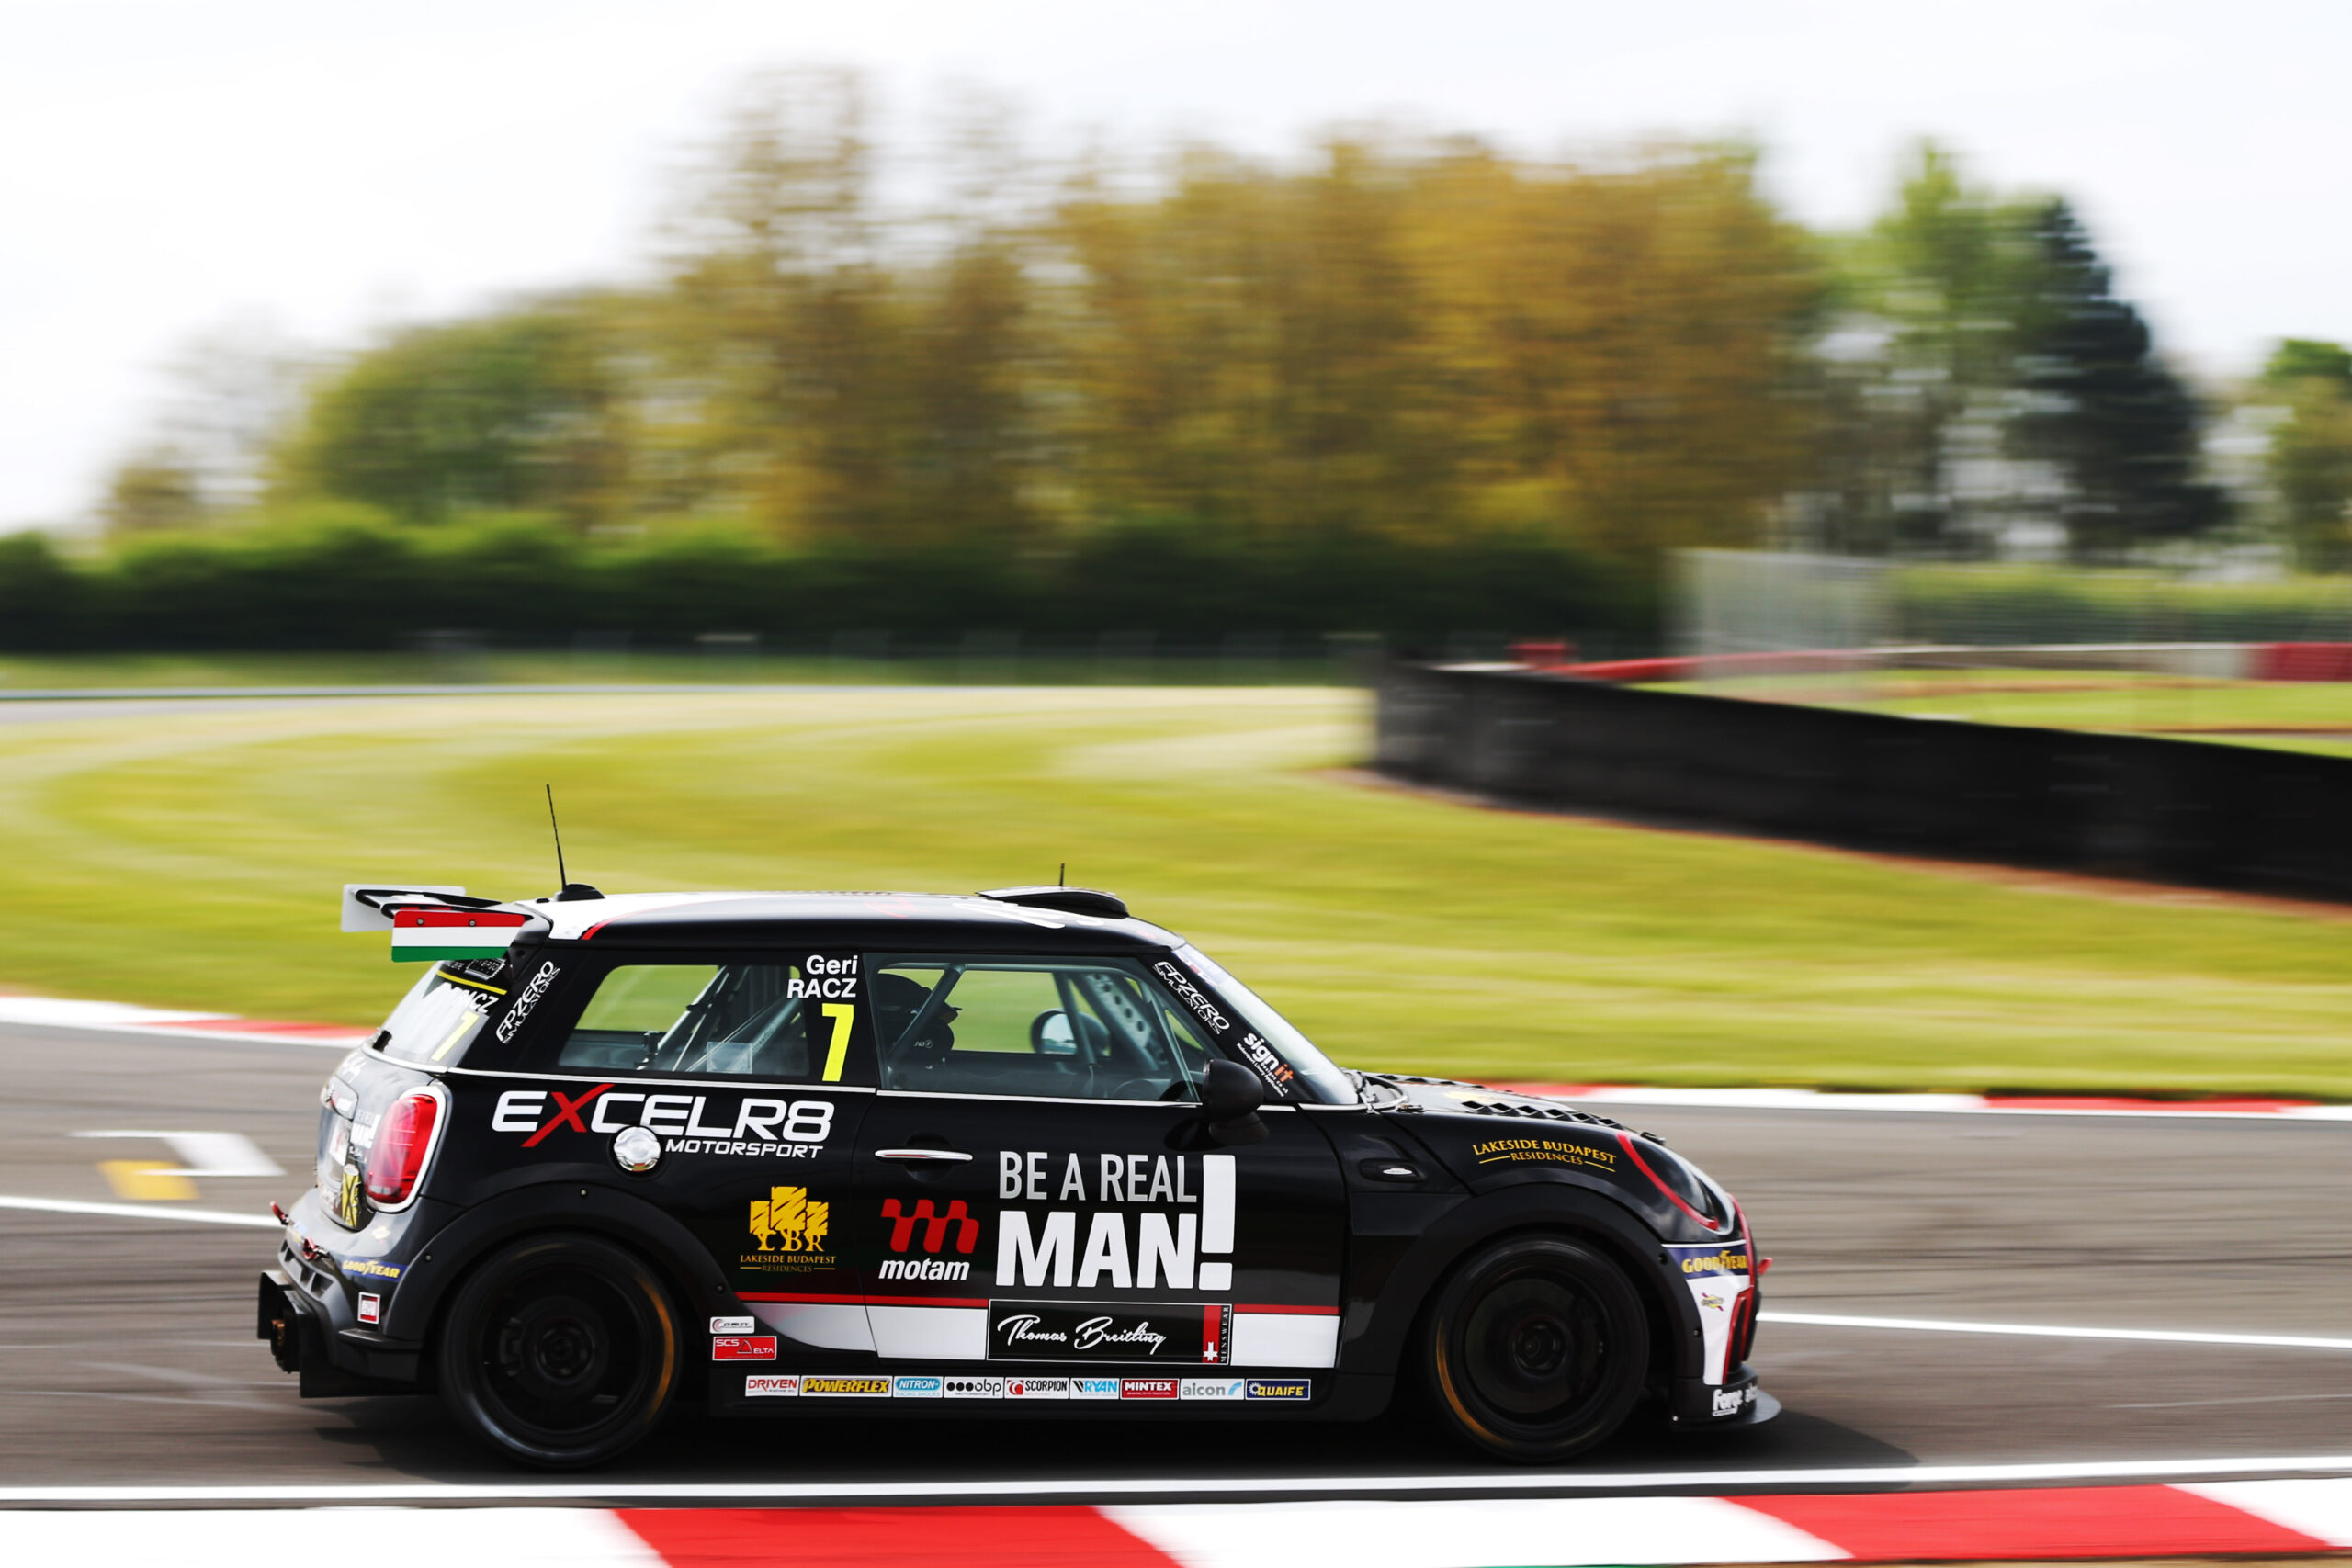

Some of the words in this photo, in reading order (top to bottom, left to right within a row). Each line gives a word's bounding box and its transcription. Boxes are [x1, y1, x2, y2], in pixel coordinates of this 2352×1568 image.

[806, 954, 858, 975] Geri
[786, 977, 857, 998] RACZ
[431, 1010, 480, 1062] 7
[821, 1002, 854, 1082] 7
[492, 1083, 835, 1147] EXCELR8
[665, 1139, 823, 1159] MOTORSPORT
[1472, 1139, 1540, 1156] LAKESIDE
[1542, 1140, 1617, 1164] BUDAPEST
[1510, 1151, 1584, 1165] RESIDENCES
[999, 1150, 1048, 1200] BE
[1059, 1152, 1086, 1201] A
[1100, 1153, 1197, 1203] REAL
[996, 1155, 1236, 1291] MAN!
[740, 1254, 785, 1264] LAKESIDE
[787, 1255, 837, 1265] BUDAPEST
[761, 1264, 813, 1273] RESIDENCES
[878, 1258, 970, 1281] motam
[997, 1314, 1068, 1347] Thomas
[1073, 1316, 1167, 1355] Breitling
[1220, 1306, 1229, 1363] MENSWEAR
[748, 1379, 797, 1392] DRIVEN
[802, 1378, 890, 1393] POWERFLEX
[1025, 1381, 1068, 1392] SCORPION
[1084, 1380, 1118, 1393] RYAN
[1125, 1382, 1172, 1391] MINTEX
[1182, 1382, 1226, 1396] alcon
[1257, 1386, 1305, 1397] QUAIFE
